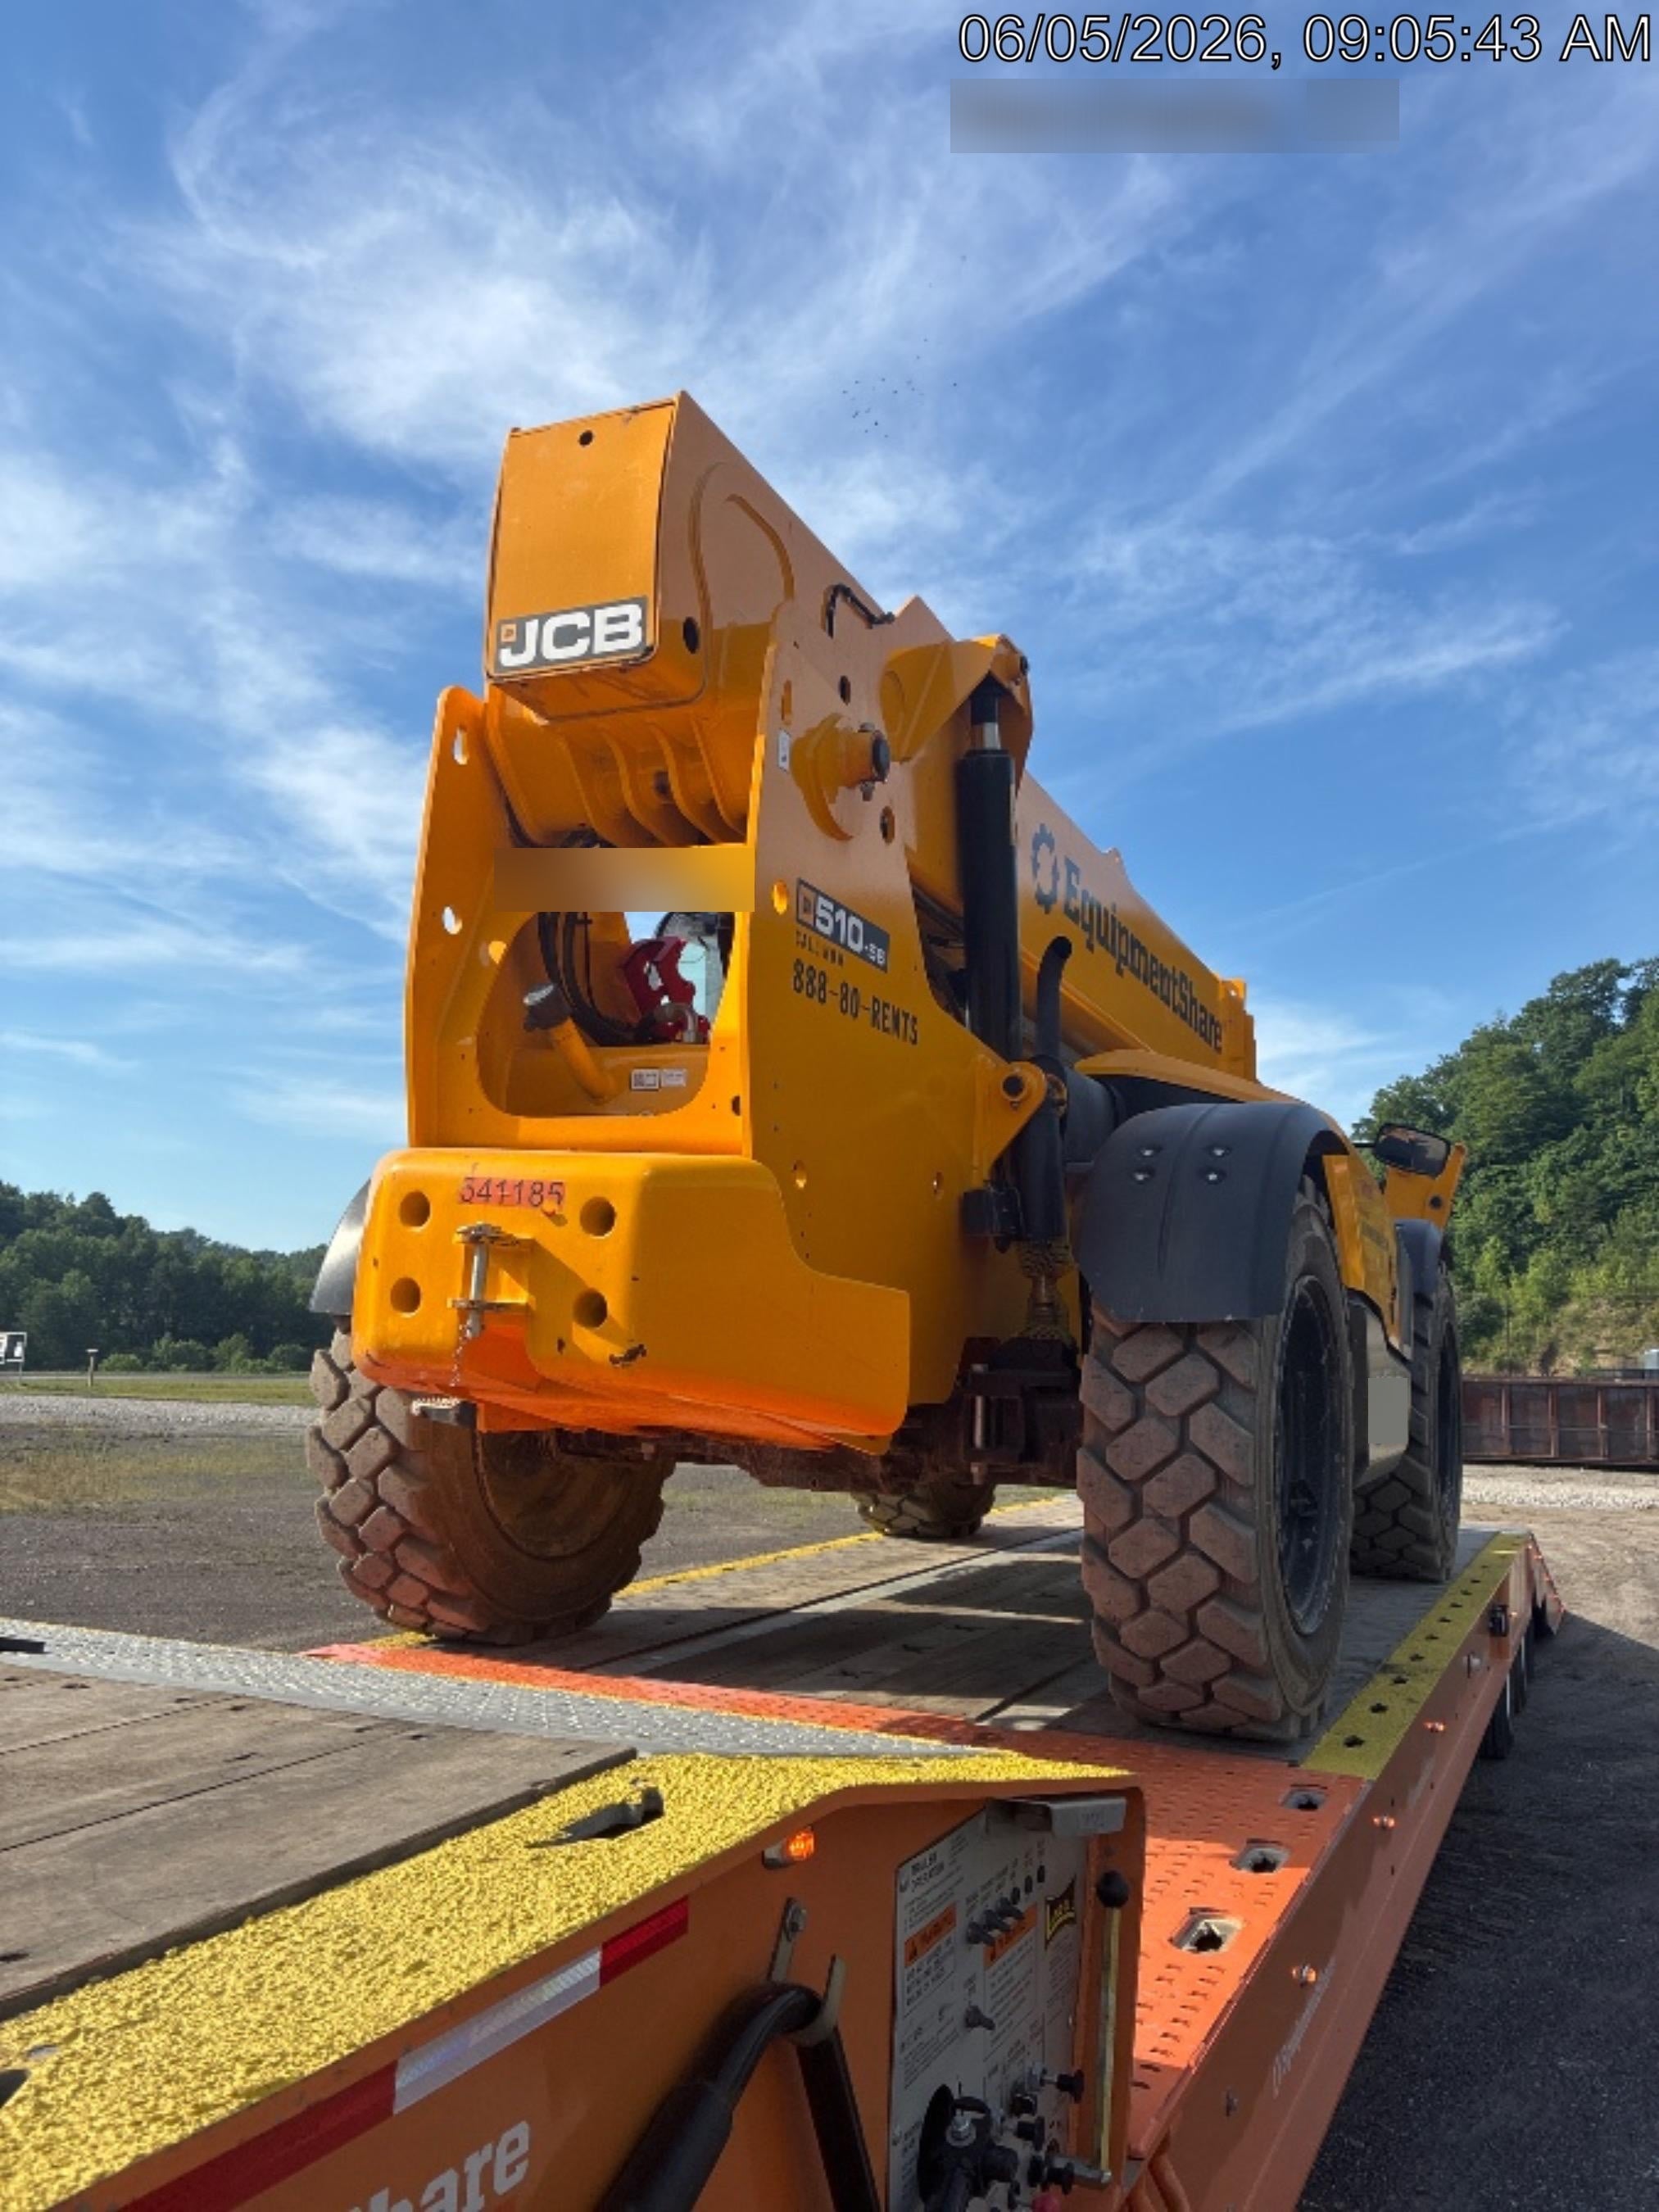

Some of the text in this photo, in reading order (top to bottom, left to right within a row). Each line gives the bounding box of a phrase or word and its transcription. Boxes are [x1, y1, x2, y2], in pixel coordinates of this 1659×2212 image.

[498, 603, 643, 668] JCB
[1064, 857, 1222, 1055] EquipmentShare
[792, 958, 918, 1045] 888-80-RENTS
